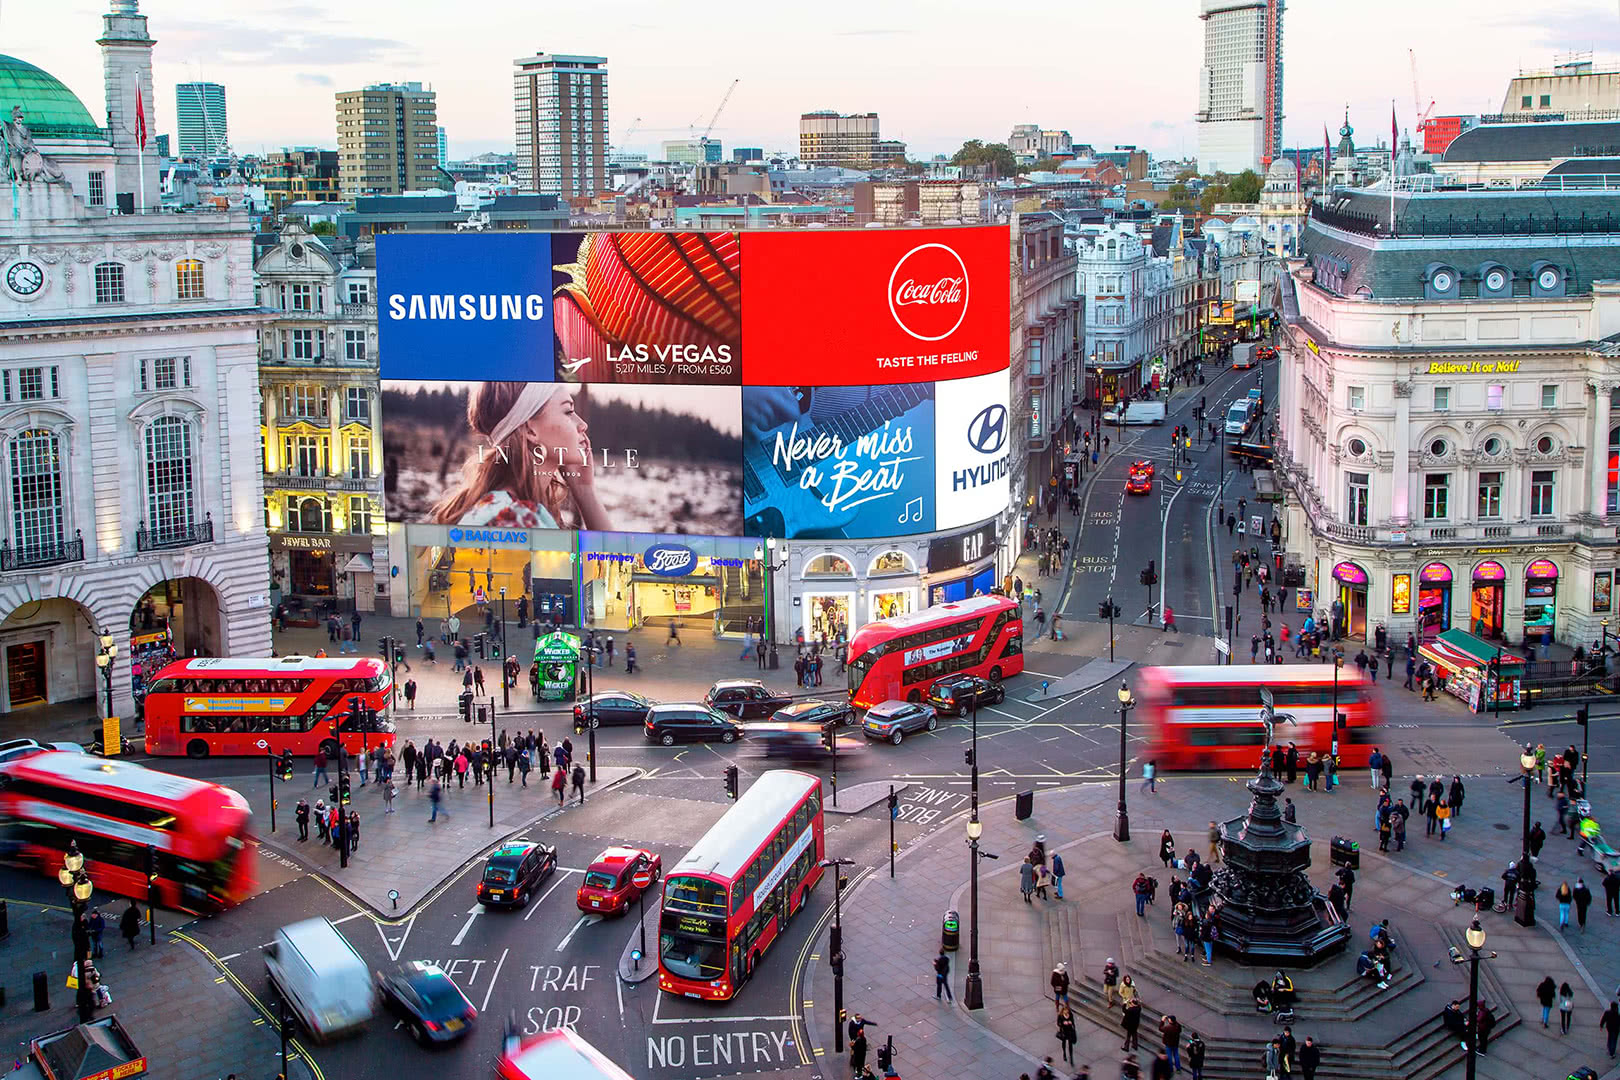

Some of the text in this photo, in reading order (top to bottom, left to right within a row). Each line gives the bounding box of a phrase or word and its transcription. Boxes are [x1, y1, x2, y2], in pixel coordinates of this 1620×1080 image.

[896, 277, 964, 306] Coca-Cola
[389, 294, 544, 321] SAMSUNG
[606, 344, 732, 363] LAS VEGAS
[877, 350, 978, 368] TASTE THE FEELING
[615, 364, 732, 375] 5,217 MILES / FROM £560
[1429, 360, 1520, 374] Believe It or Not!
[476, 445, 640, 469] IN STYLE
[772, 420, 913, 471] Never miss
[800, 455, 925, 513] a Beat
[281, 537, 331, 548] JEWEL BAR
[465, 530, 527, 543] BARCLAYS
[963, 532, 983, 562] GAP
[110, 555, 161, 567] ALLIANC
[587, 552, 635, 564] pharmacy
[648, 549, 691, 572] Boots
[710, 557, 744, 569] beauty
[1082, 556, 1109, 564] BUS
[903, 786, 970, 809] LANE
[897, 803, 942, 826] BUS
[529, 965, 601, 992] TRAF
[647, 1030, 788, 1069] NO ENTRY
